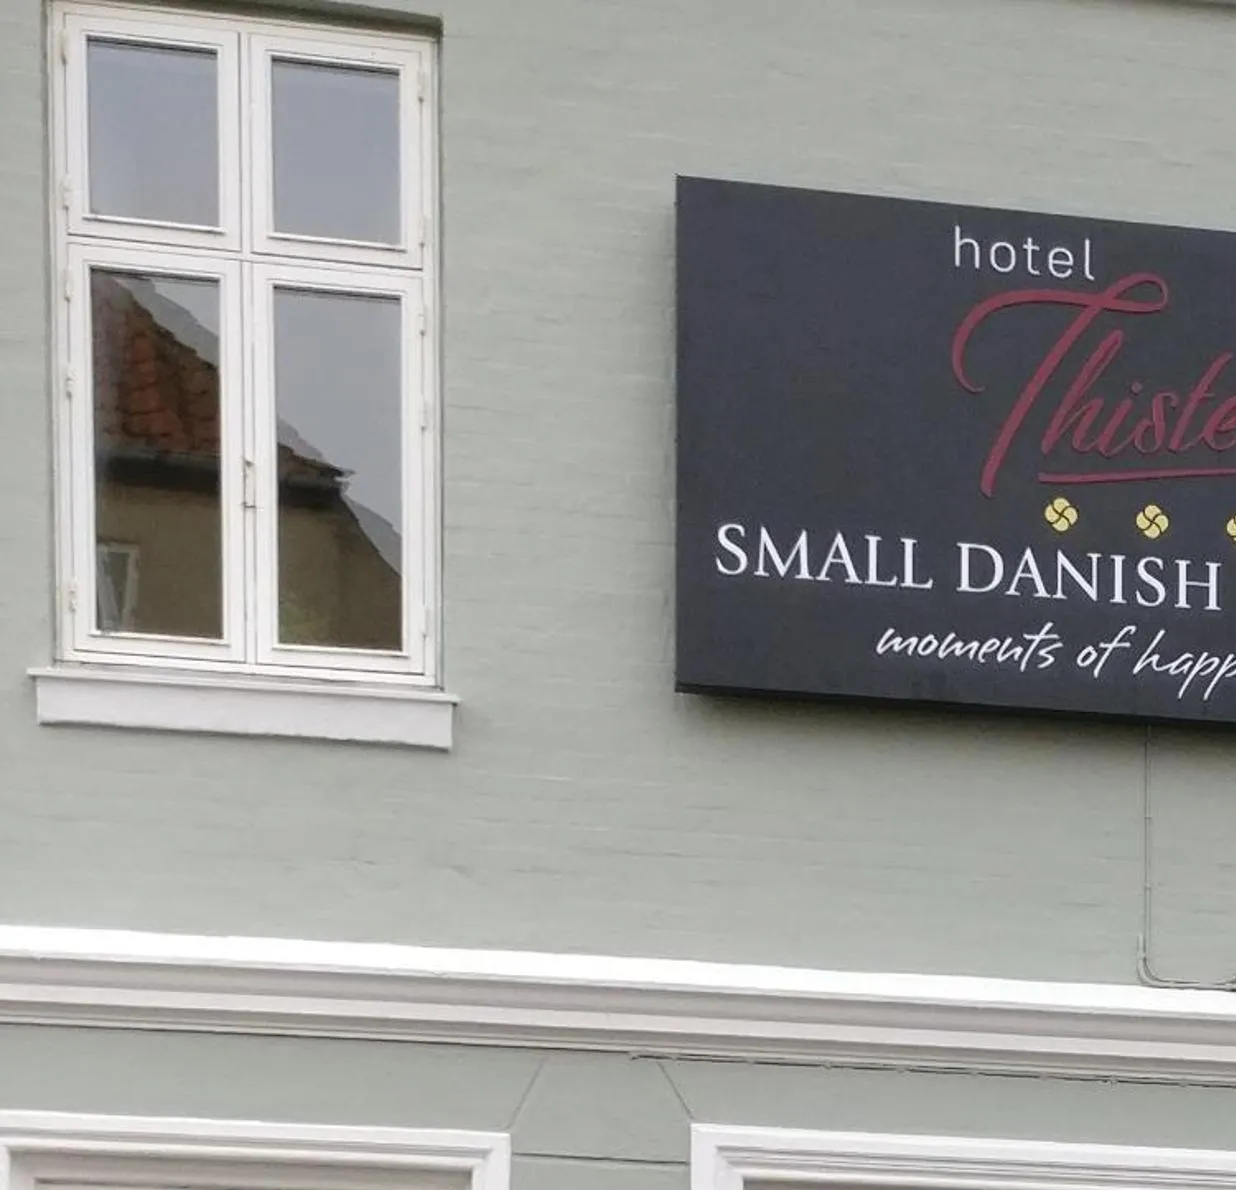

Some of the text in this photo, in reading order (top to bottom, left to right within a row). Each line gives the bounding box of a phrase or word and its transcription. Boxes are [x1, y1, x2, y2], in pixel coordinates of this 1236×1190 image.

[953, 224, 1096, 281] hotel
[714, 522, 934, 590] SMALL
[955, 541, 1223, 612] DANISH
[875, 621, 1063, 673] moments
[1076, 625, 1137, 678] of
